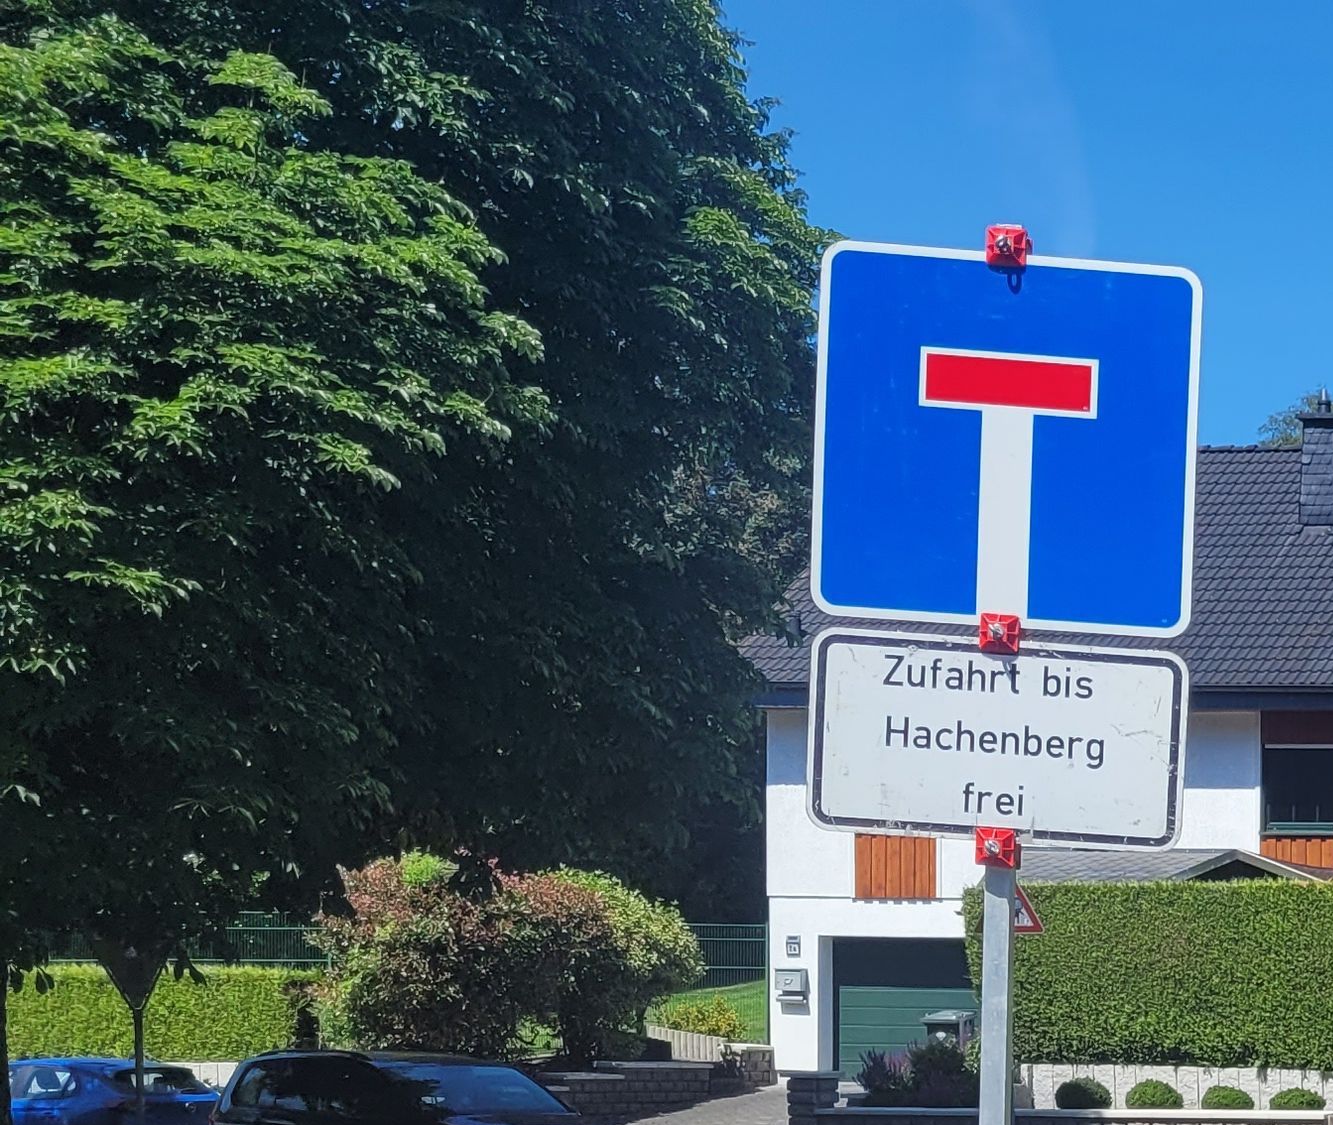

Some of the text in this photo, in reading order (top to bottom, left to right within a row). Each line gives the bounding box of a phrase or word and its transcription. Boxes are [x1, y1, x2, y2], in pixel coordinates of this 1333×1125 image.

[882, 654, 1094, 699] Zufahrt bis
[884, 715, 1105, 770] Hachenberg
[962, 782, 1024, 817] frei
